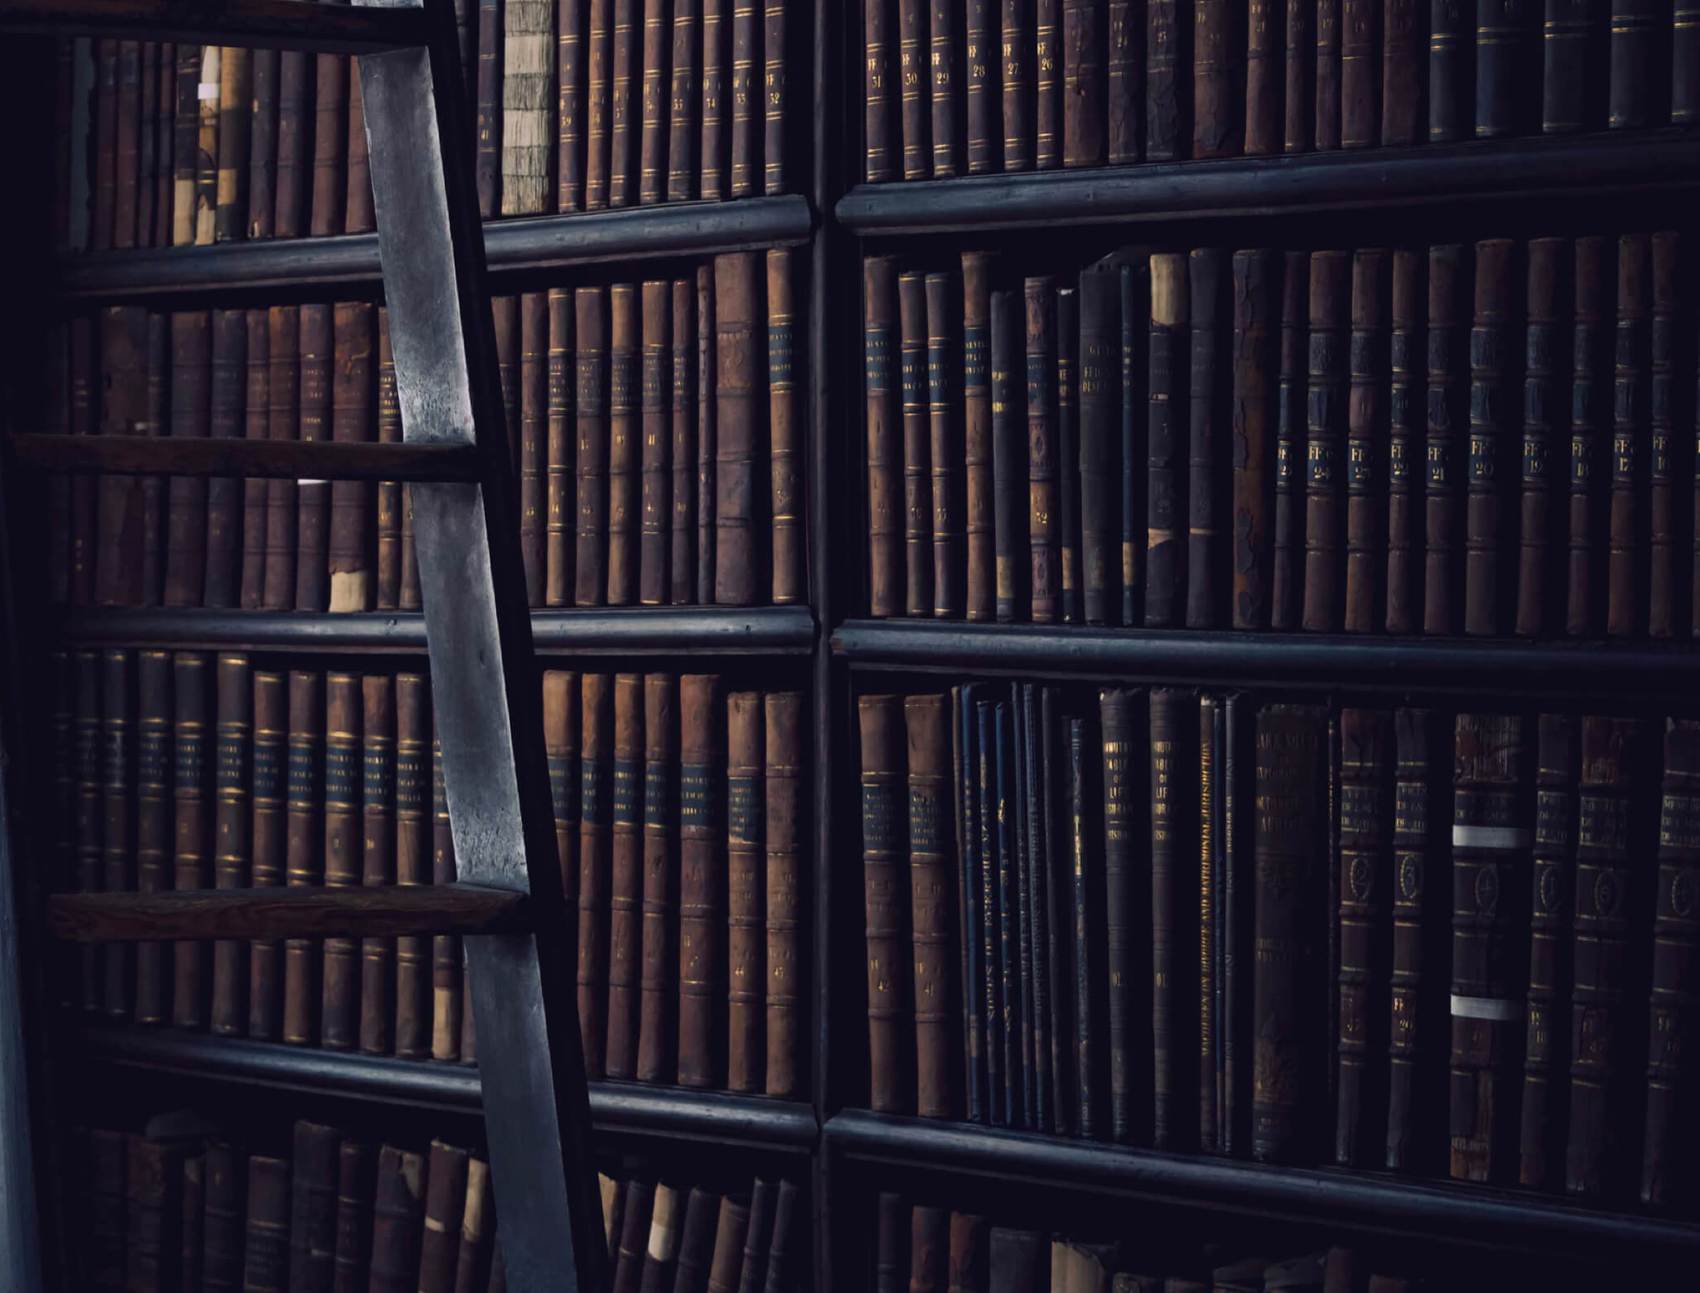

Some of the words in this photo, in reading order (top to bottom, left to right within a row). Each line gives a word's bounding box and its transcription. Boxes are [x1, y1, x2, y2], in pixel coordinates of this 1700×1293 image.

[973, 64, 985, 77] 28
[1008, 62, 1019, 75] 27
[1042, 57, 1053, 71] 26
[936, 72, 949, 84] 29
[1200, 742, 1210, 818] JURISDICTION
[1200, 822, 1210, 896] MATRIMONIAL
[1200, 898, 1210, 921] AND
